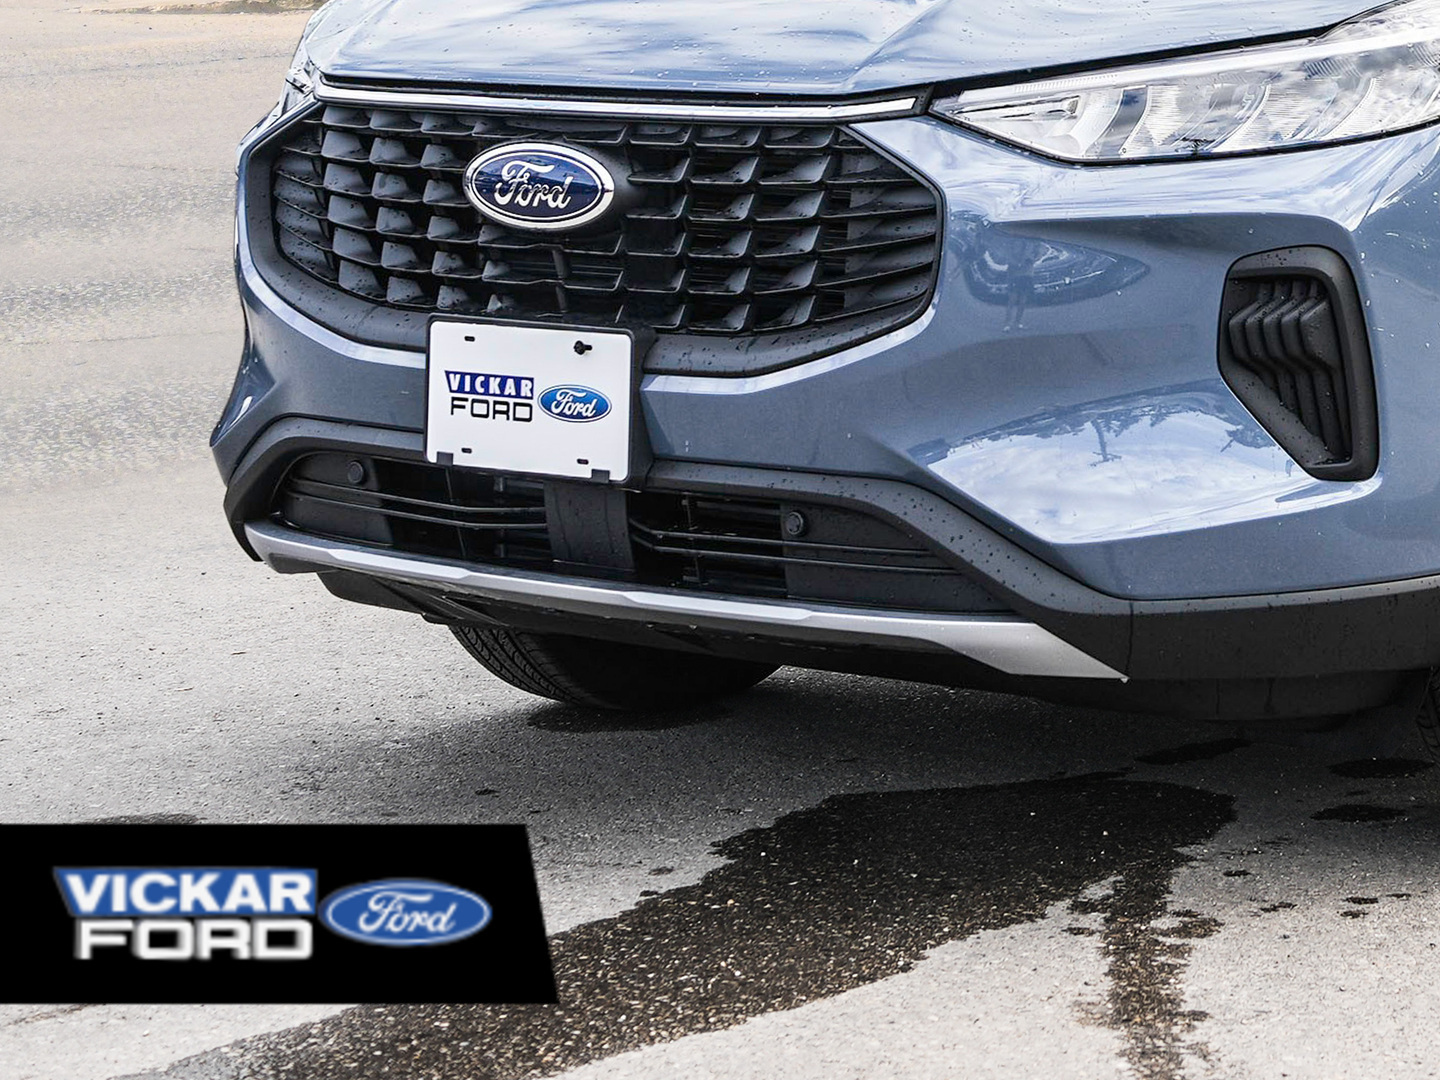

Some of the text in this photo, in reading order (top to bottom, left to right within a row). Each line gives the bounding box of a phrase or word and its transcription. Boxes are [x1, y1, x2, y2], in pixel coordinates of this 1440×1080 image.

[493, 159, 575, 210] Ford
[448, 372, 534, 398] VICKAR
[450, 396, 534, 423] FORD
[551, 389, 598, 418] Ford
